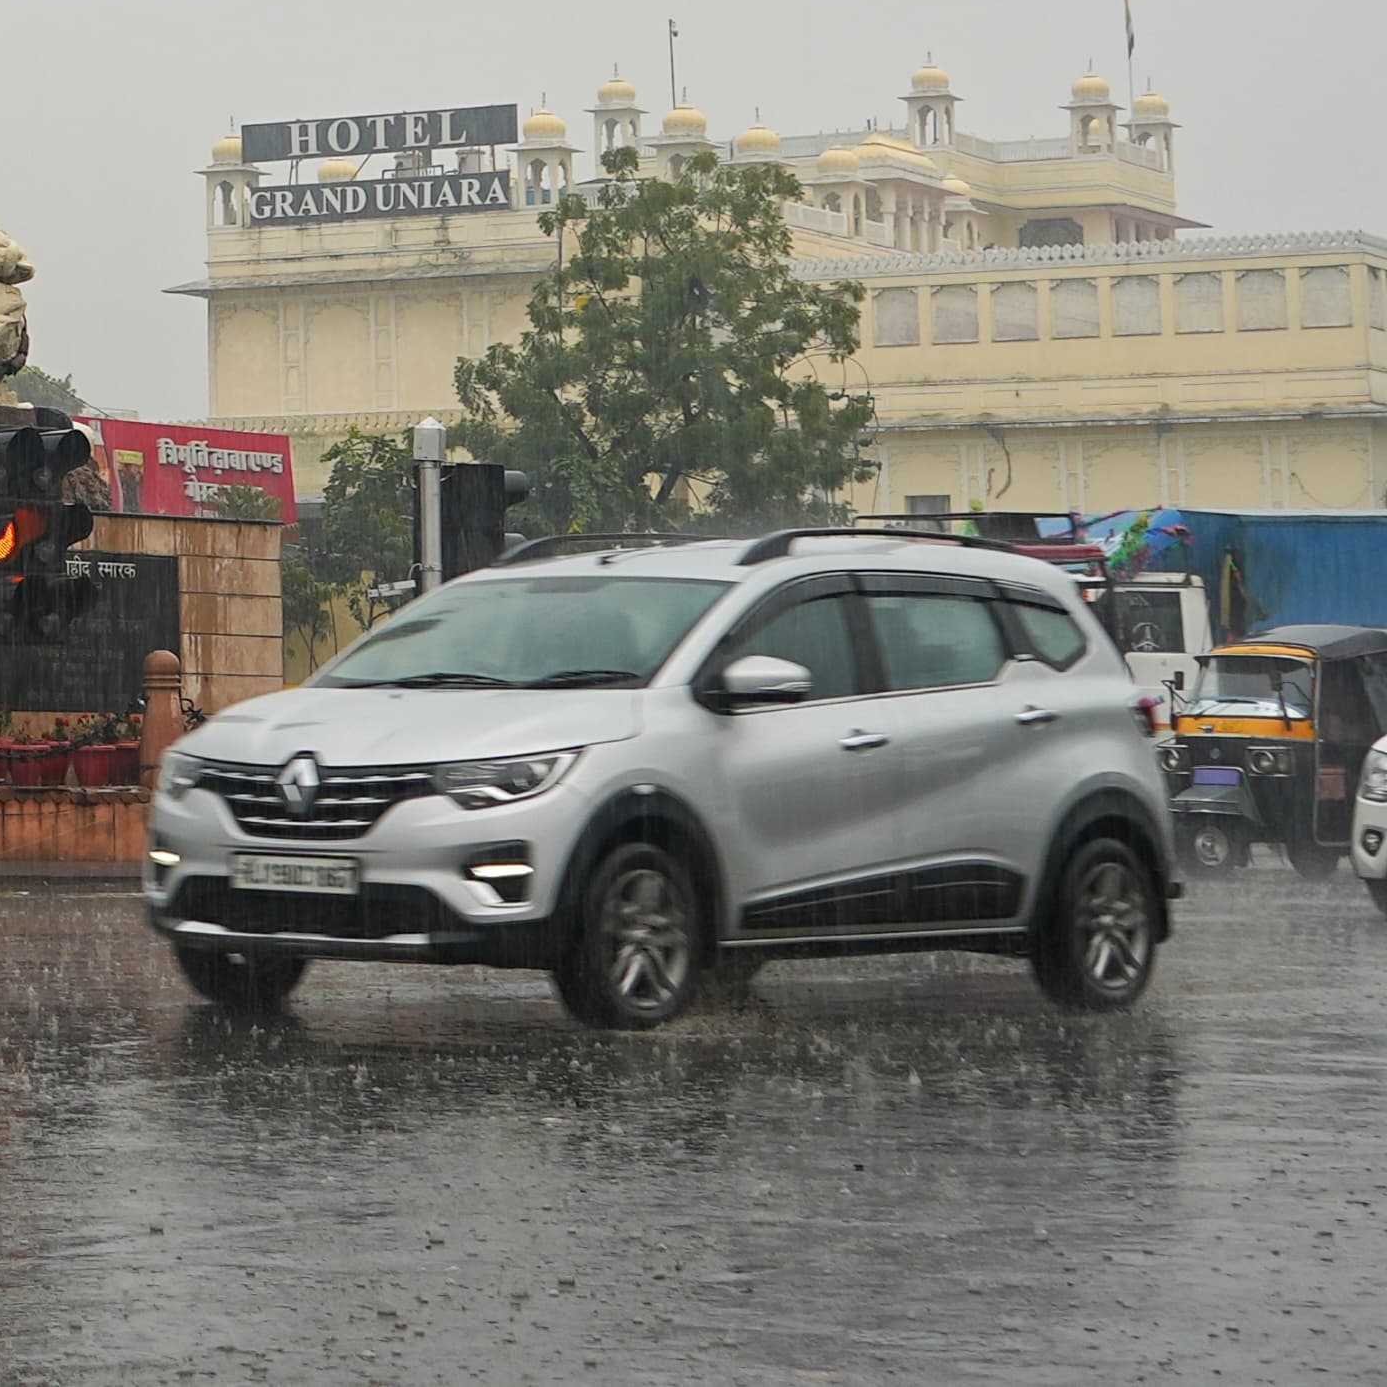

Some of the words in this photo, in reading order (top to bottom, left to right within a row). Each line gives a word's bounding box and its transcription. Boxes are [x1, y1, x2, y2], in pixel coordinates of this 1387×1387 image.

[286, 110, 467, 157] HOTEL
[249, 185, 367, 220] GRAND
[375, 177, 509, 212] UNIARA
[156, 437, 209, 474] त्रिमूर्ति
[97, 561, 137, 579] स्मारक
